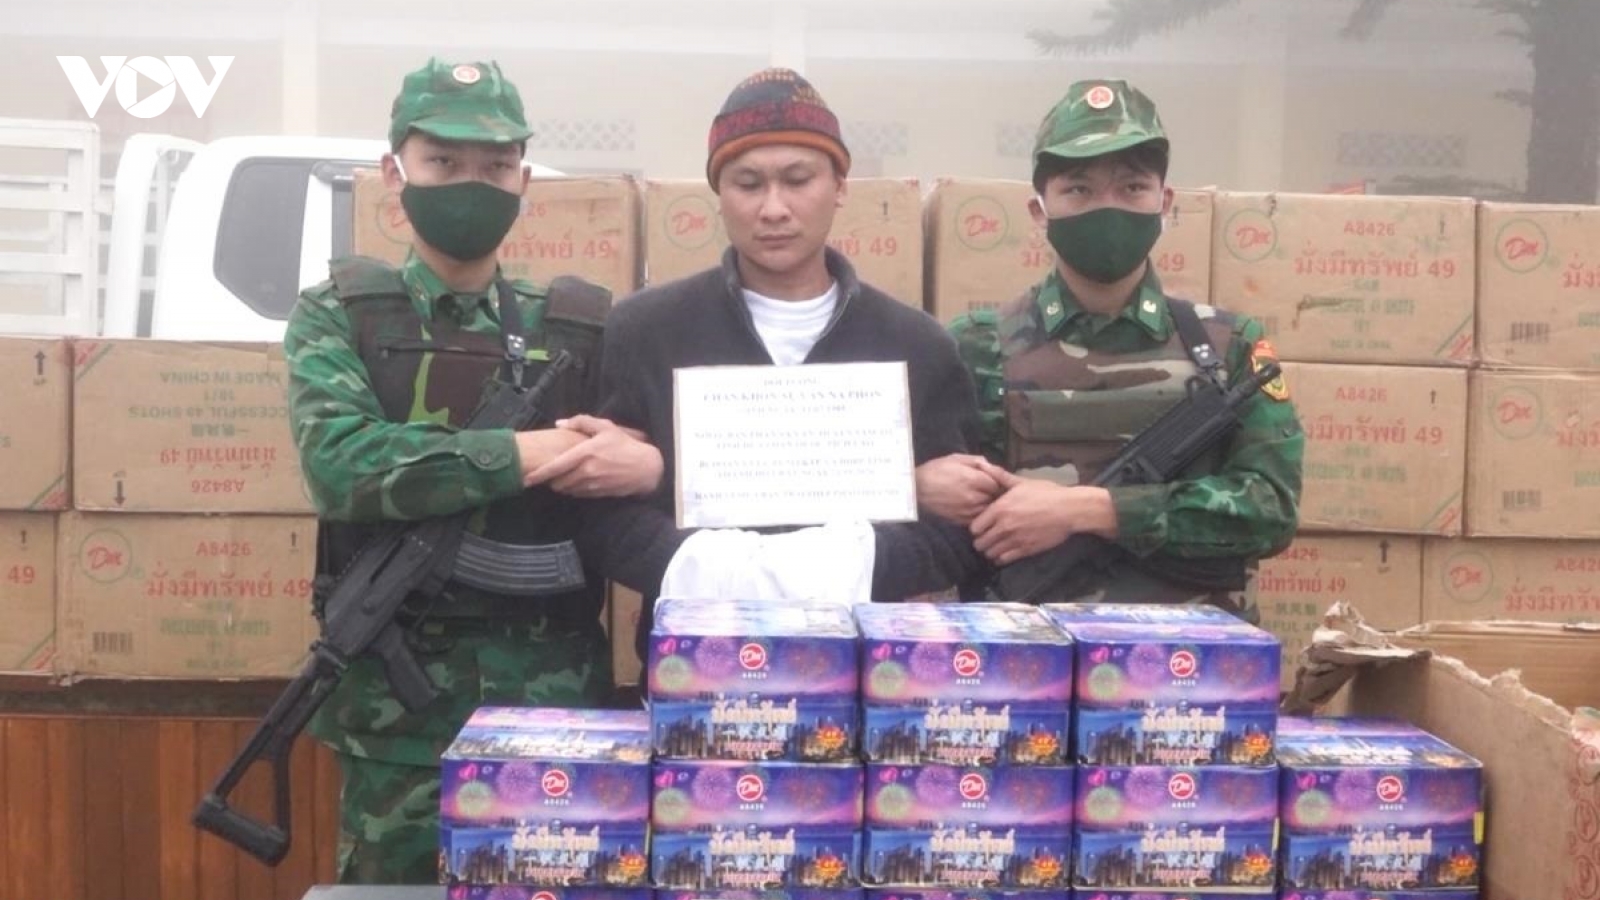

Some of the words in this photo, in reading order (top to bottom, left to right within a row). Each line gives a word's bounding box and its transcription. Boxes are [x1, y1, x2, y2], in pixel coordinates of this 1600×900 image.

[1344, 220, 1396, 237] A8426
[582, 240, 610, 259] 49
[869, 236, 898, 256] 49
[1157, 253, 1185, 272] 49
[1428, 258, 1456, 279] 49
[1335, 386, 1388, 402] A8426
[1415, 425, 1444, 445] 49
[159, 448, 181, 464] 49
[191, 478, 246, 494] A8426
[196, 542, 253, 557] A8426
[1555, 556, 1600, 572] A842
[8, 565, 35, 585] 49
[1327, 575, 1346, 593] 49
[283, 578, 311, 598] 49
